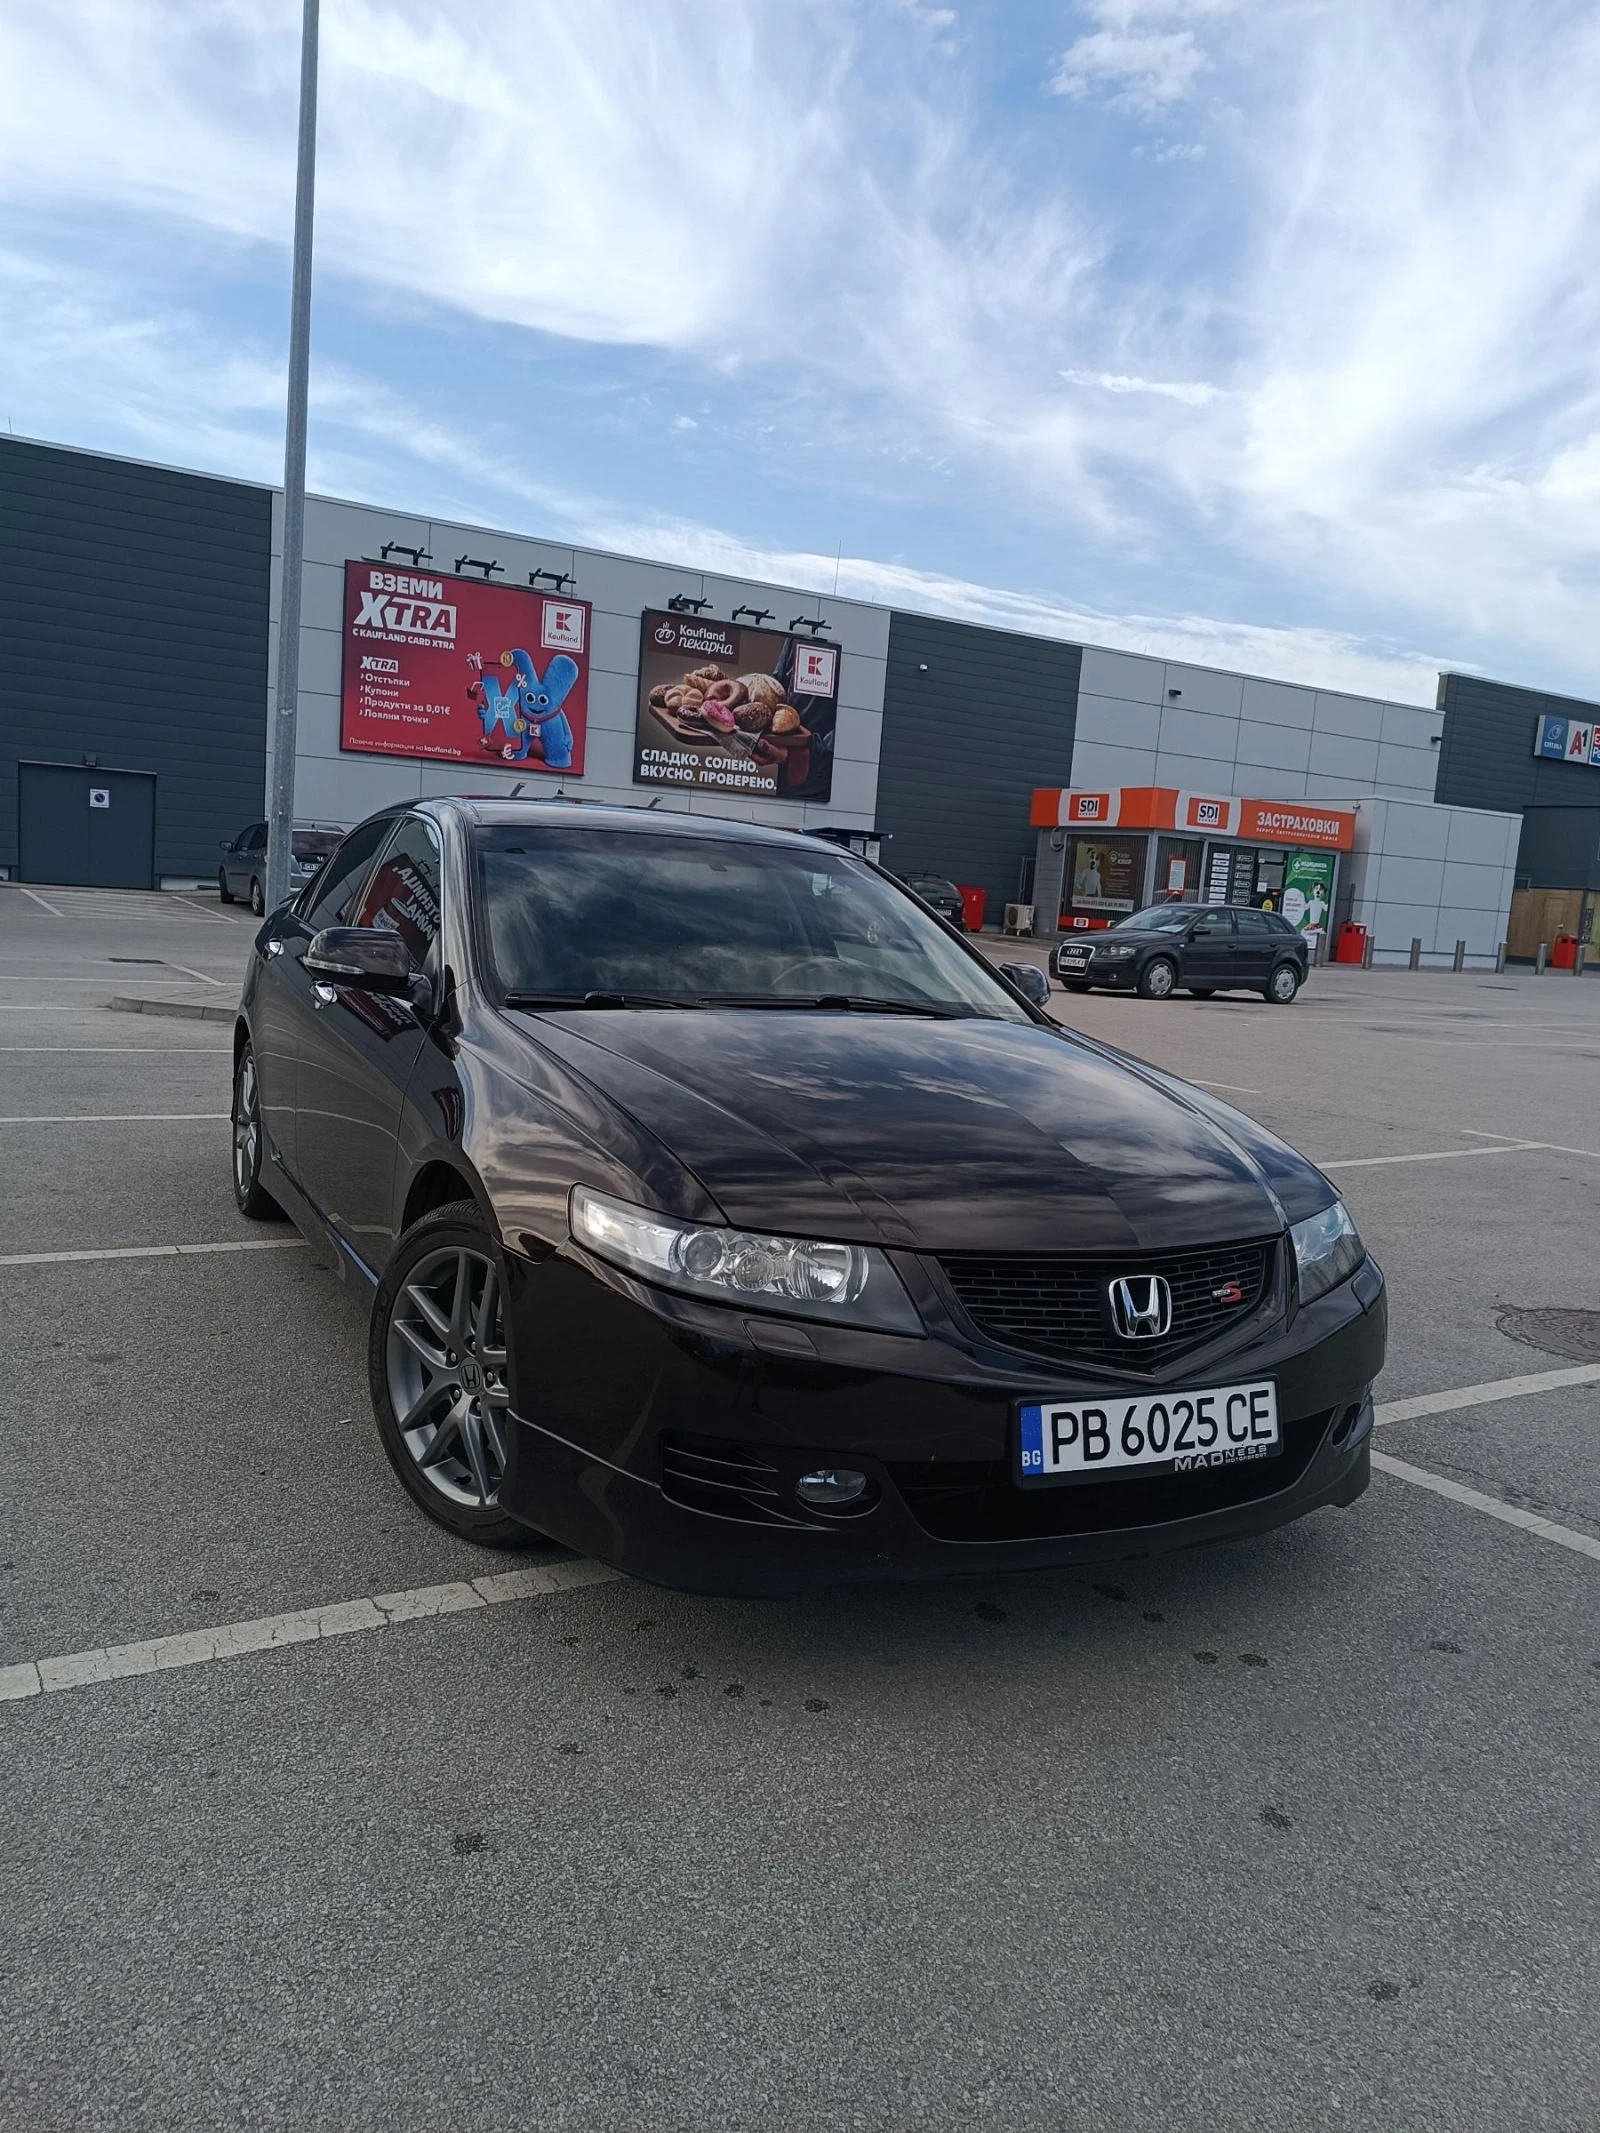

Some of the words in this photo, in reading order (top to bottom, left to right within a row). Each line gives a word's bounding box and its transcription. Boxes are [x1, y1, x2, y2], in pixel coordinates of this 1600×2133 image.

[370, 570, 443, 600] ВЗЕМИ
[353, 591, 456, 638] XTRA
[360, 628, 406, 643] KAUFLAND
[407, 636, 431, 647] CARD
[432, 640, 455, 650] XTRA
[547, 632, 579, 643] Kaufland
[680, 624, 726, 641] Kaufland
[678, 636, 734, 656] пекарна
[360, 656, 398, 673] XTRA
[365, 673, 410, 687] Отстъпки
[800, 676, 829, 688] Kaufland
[364, 685, 399, 697] Купони
[364, 696, 411, 710] Продукти
[413, 704, 423, 712] за
[426, 704, 450, 715] 0,01€
[364, 709, 399, 721] Лоялни
[401, 714, 429, 724] точки
[349, 737, 373, 746] Повече
[375, 740, 415, 751] информация
[424, 743, 461, 756] kaufland.bg
[1569, 729, 1588, 755] A1
[641, 749, 702, 767] СЛАДКО.
[705, 756, 759, 773] СОЛЕНО.
[640, 764, 696, 781] ВКУСНО.
[699, 771, 777, 790] ПРОВЕРЕНО.
[1080, 800, 1098, 812] SDI
[1199, 805, 1218, 819] SDI
[1257, 811, 1340, 835] ЗАСТРАХОВКИ
[1050, 1408, 1111, 1465] PB
[1121, 1396, 1218, 1457] 6025
[1226, 1389, 1272, 1442] CE
[1021, 1450, 1042, 1467] BG
[1174, 1444, 1267, 1472] MADNESS
[1225, 1452, 1267, 1464] MOTORSPORT
